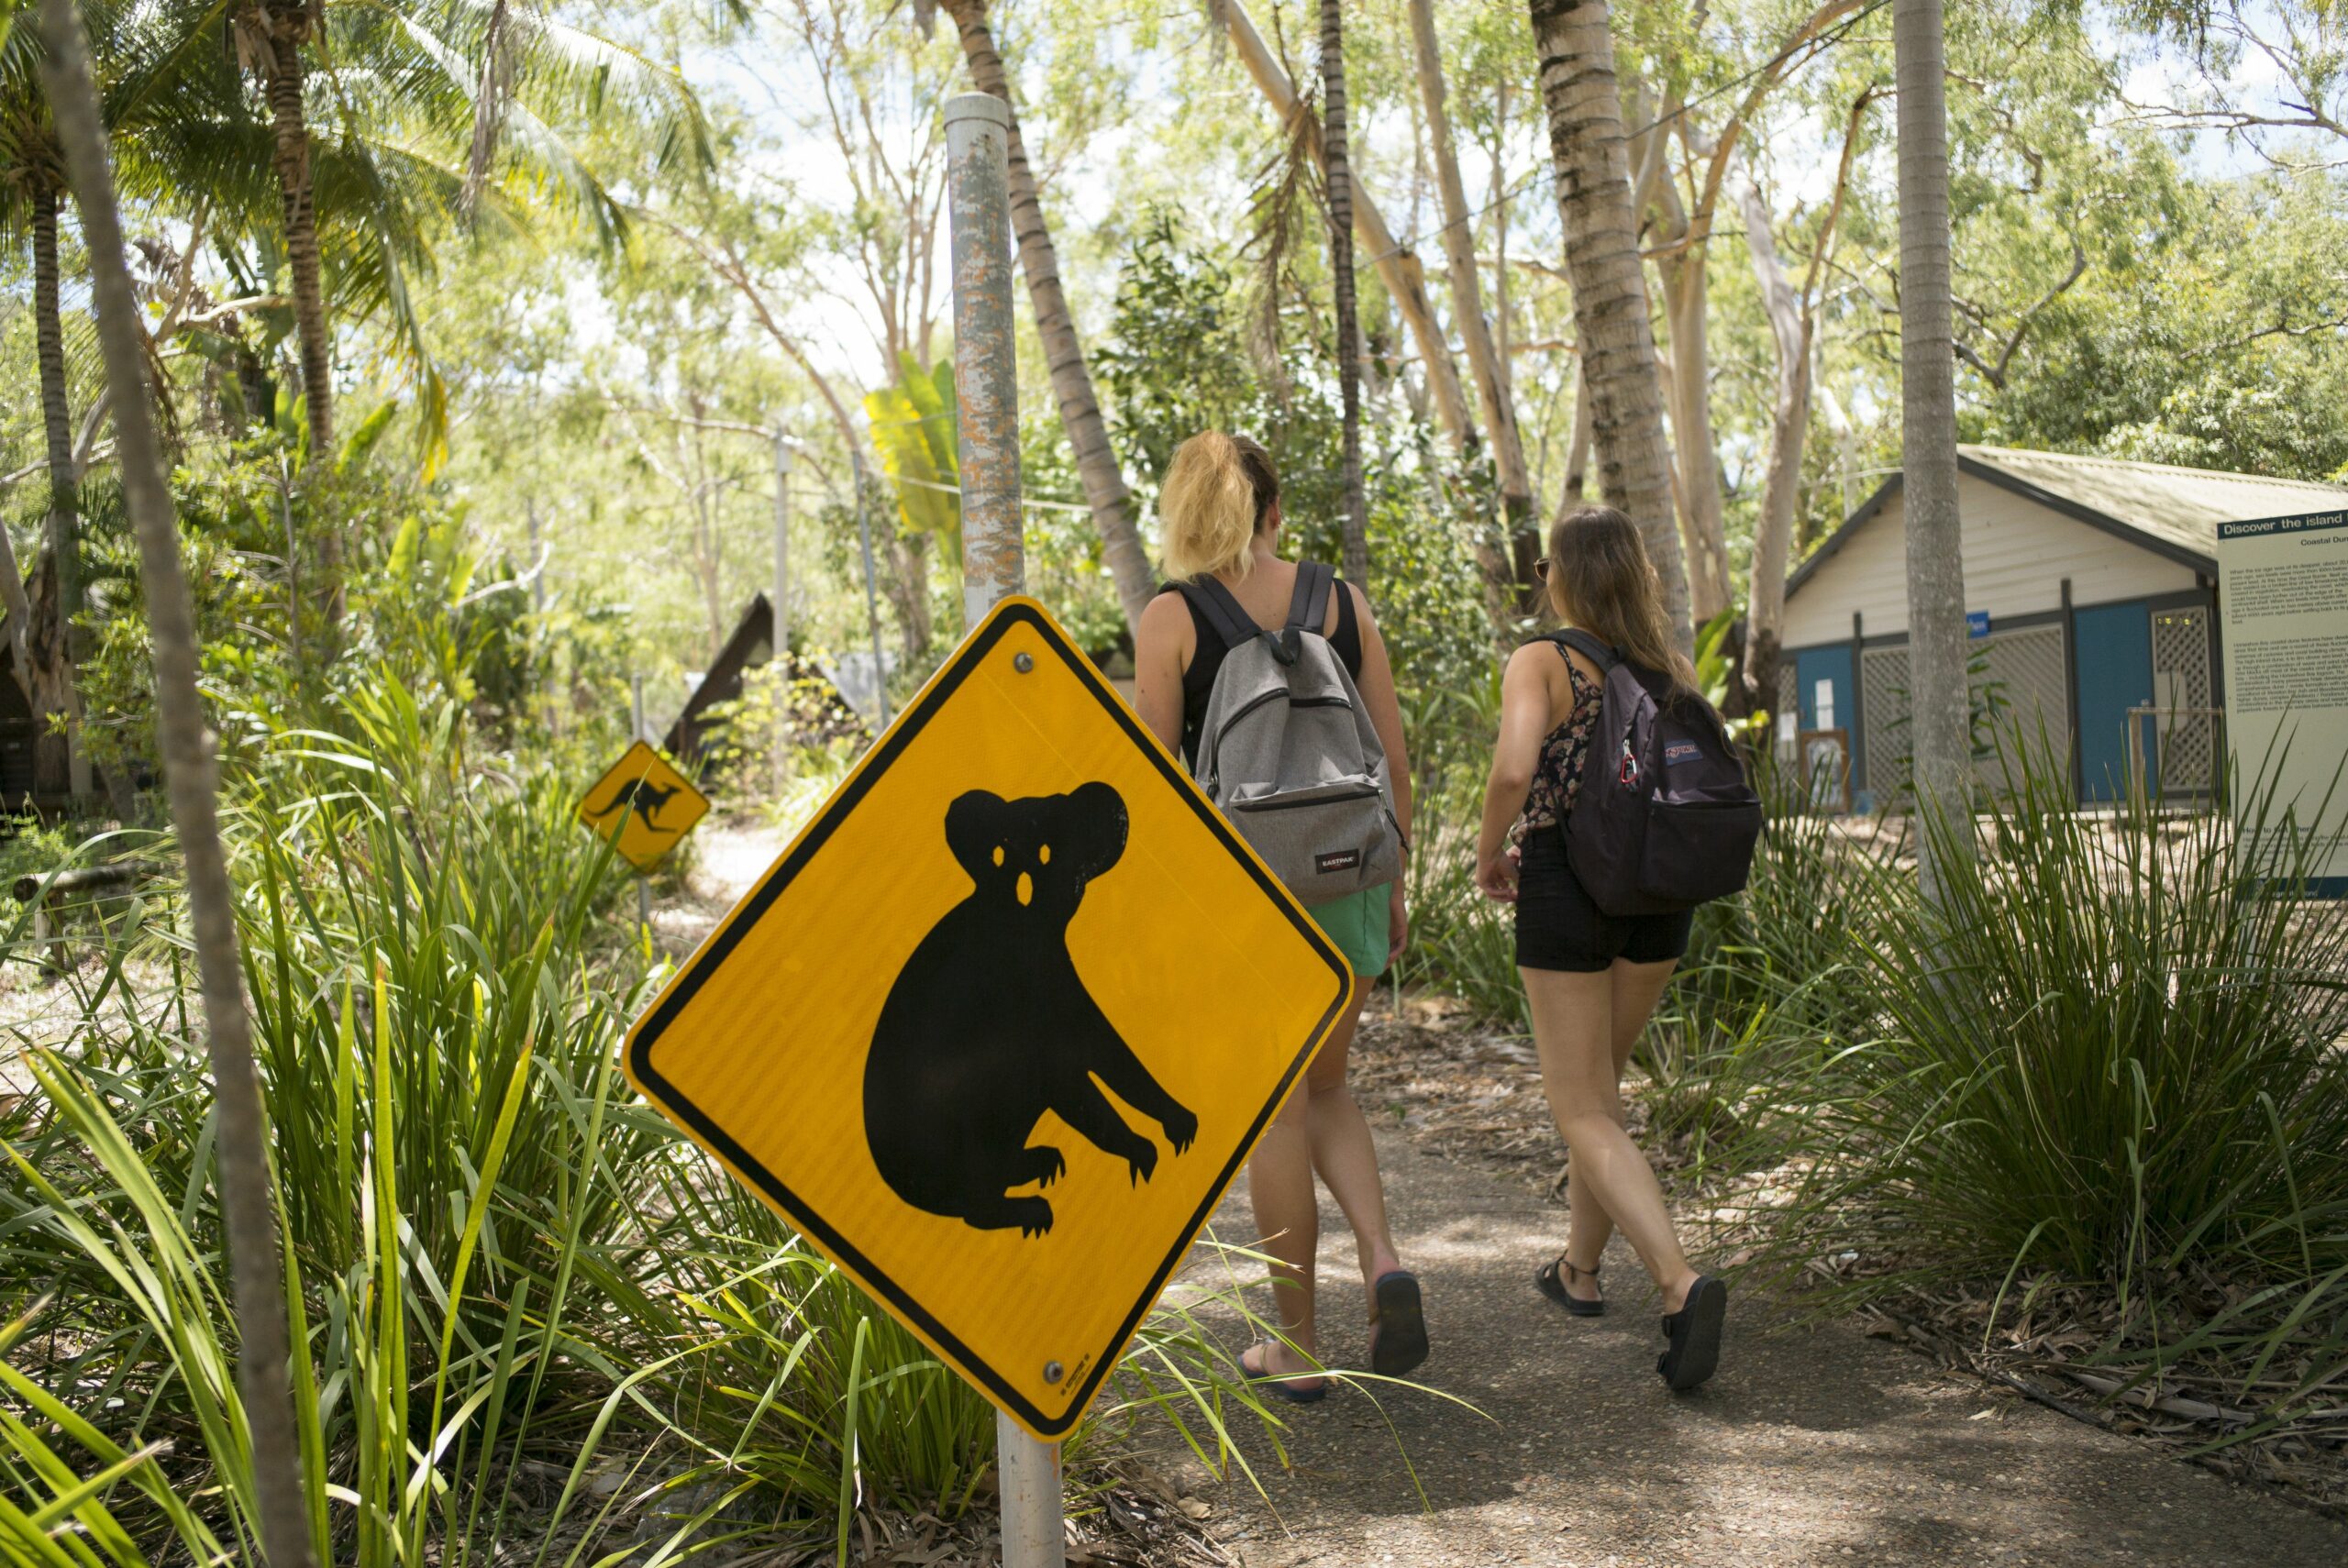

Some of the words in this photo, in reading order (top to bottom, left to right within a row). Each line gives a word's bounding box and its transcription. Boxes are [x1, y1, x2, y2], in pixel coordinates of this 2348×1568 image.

[2224, 523, 2275, 535] Discover
[2281, 519, 2301, 528] the
[2307, 514, 2342, 525] island
[2300, 537, 2331, 546] Coastal
[1322, 856, 1354, 866] EASTPAK
